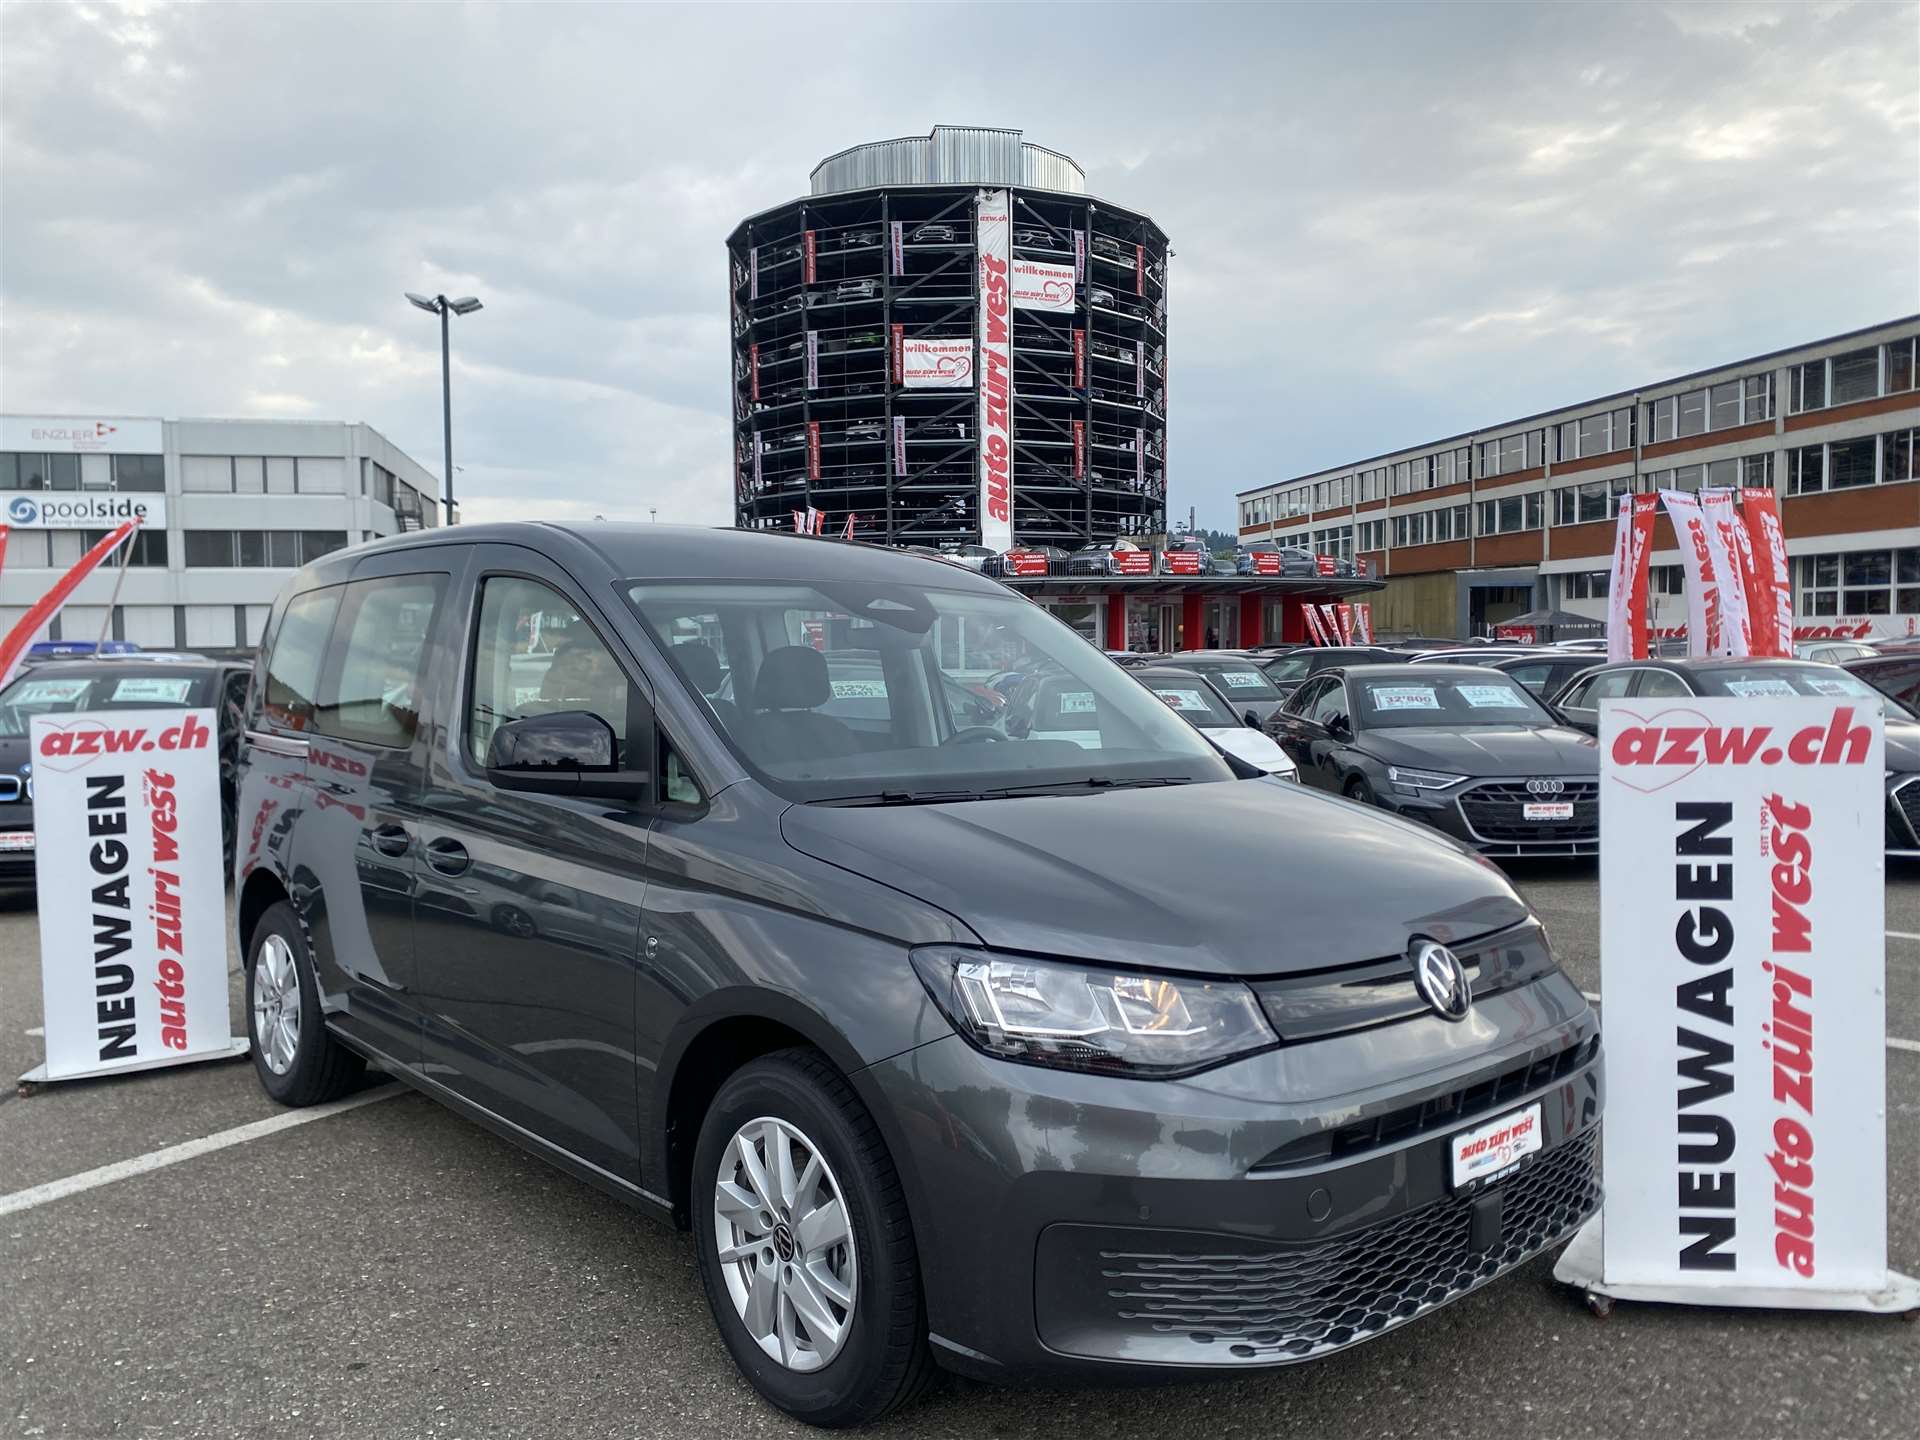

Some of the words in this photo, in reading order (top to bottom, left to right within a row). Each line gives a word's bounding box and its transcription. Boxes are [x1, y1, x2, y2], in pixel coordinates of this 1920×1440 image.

[983, 253, 1008, 343] west
[1014, 264, 1073, 279] willkommen
[905, 343, 971, 353] willkommen
[982, 347, 1008, 434] züri
[31, 429, 94, 440] ENZLER
[983, 434, 1008, 522] auto
[42, 498, 147, 524] poolside
[40, 715, 209, 757] azw.ch
[1611, 706, 1872, 766] azw.ch
[143, 768, 179, 864] west
[1760, 806, 1769, 831] 1991
[1760, 836, 1769, 857] SEIT
[148, 868, 184, 956] züri
[1761, 793, 1812, 953] west
[86, 775, 138, 1061] NEUWAGEN
[152, 960, 188, 1052] auto
[1676, 802, 1737, 1272] NEUWAGEN
[1761, 960, 1814, 1117] züri
[1460, 1140, 1487, 1160] auto
[1764, 1117, 1815, 1279] auto
